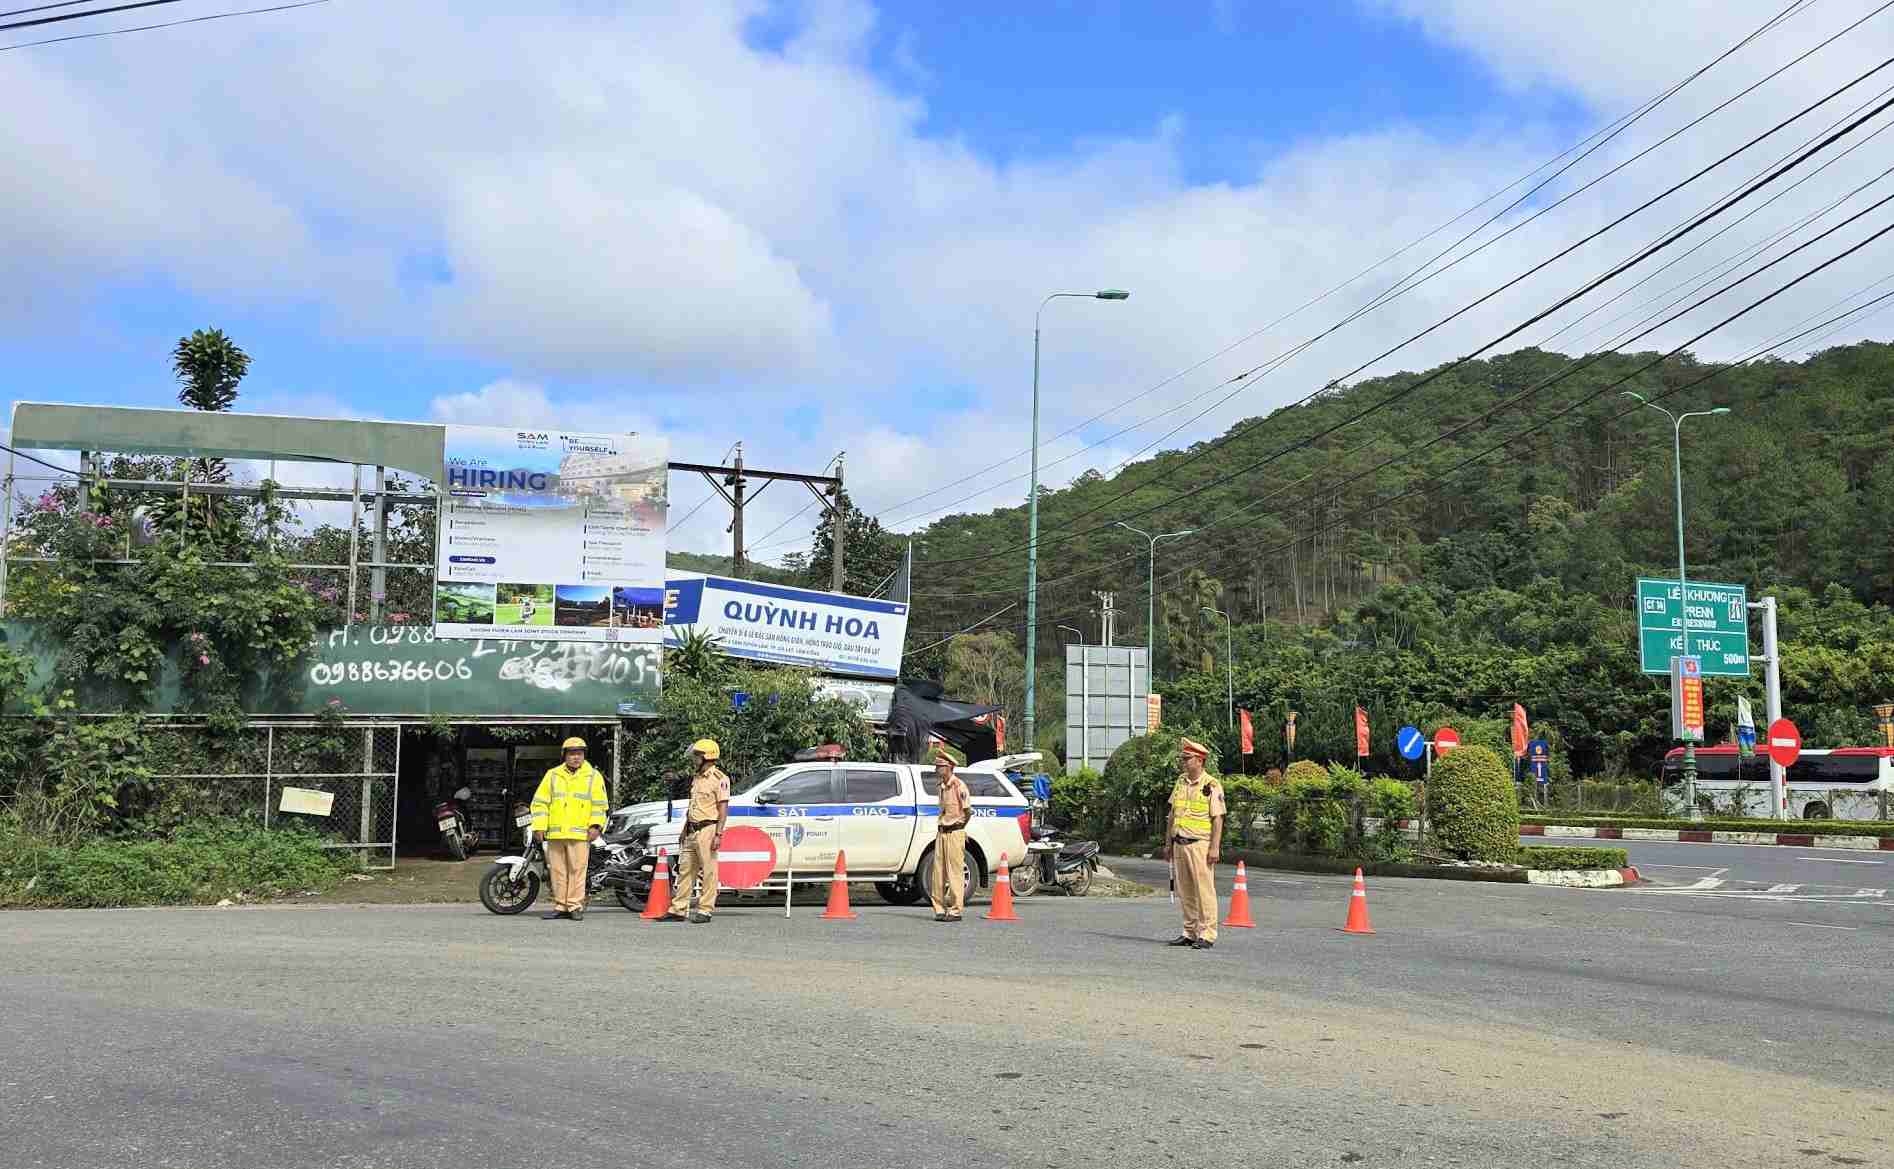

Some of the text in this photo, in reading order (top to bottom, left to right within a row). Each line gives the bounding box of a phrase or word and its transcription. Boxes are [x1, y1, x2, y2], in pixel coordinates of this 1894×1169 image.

[517, 432, 549, 441] SAM
[568, 445, 608, 453] YOURSELF
[449, 456, 487, 465] We Are
[449, 468, 546, 490] HIRING
[724, 600, 880, 640] QUỲNH HOA
[1723, 653, 1745, 665] 500m
[852, 807, 889, 817] GIAO
